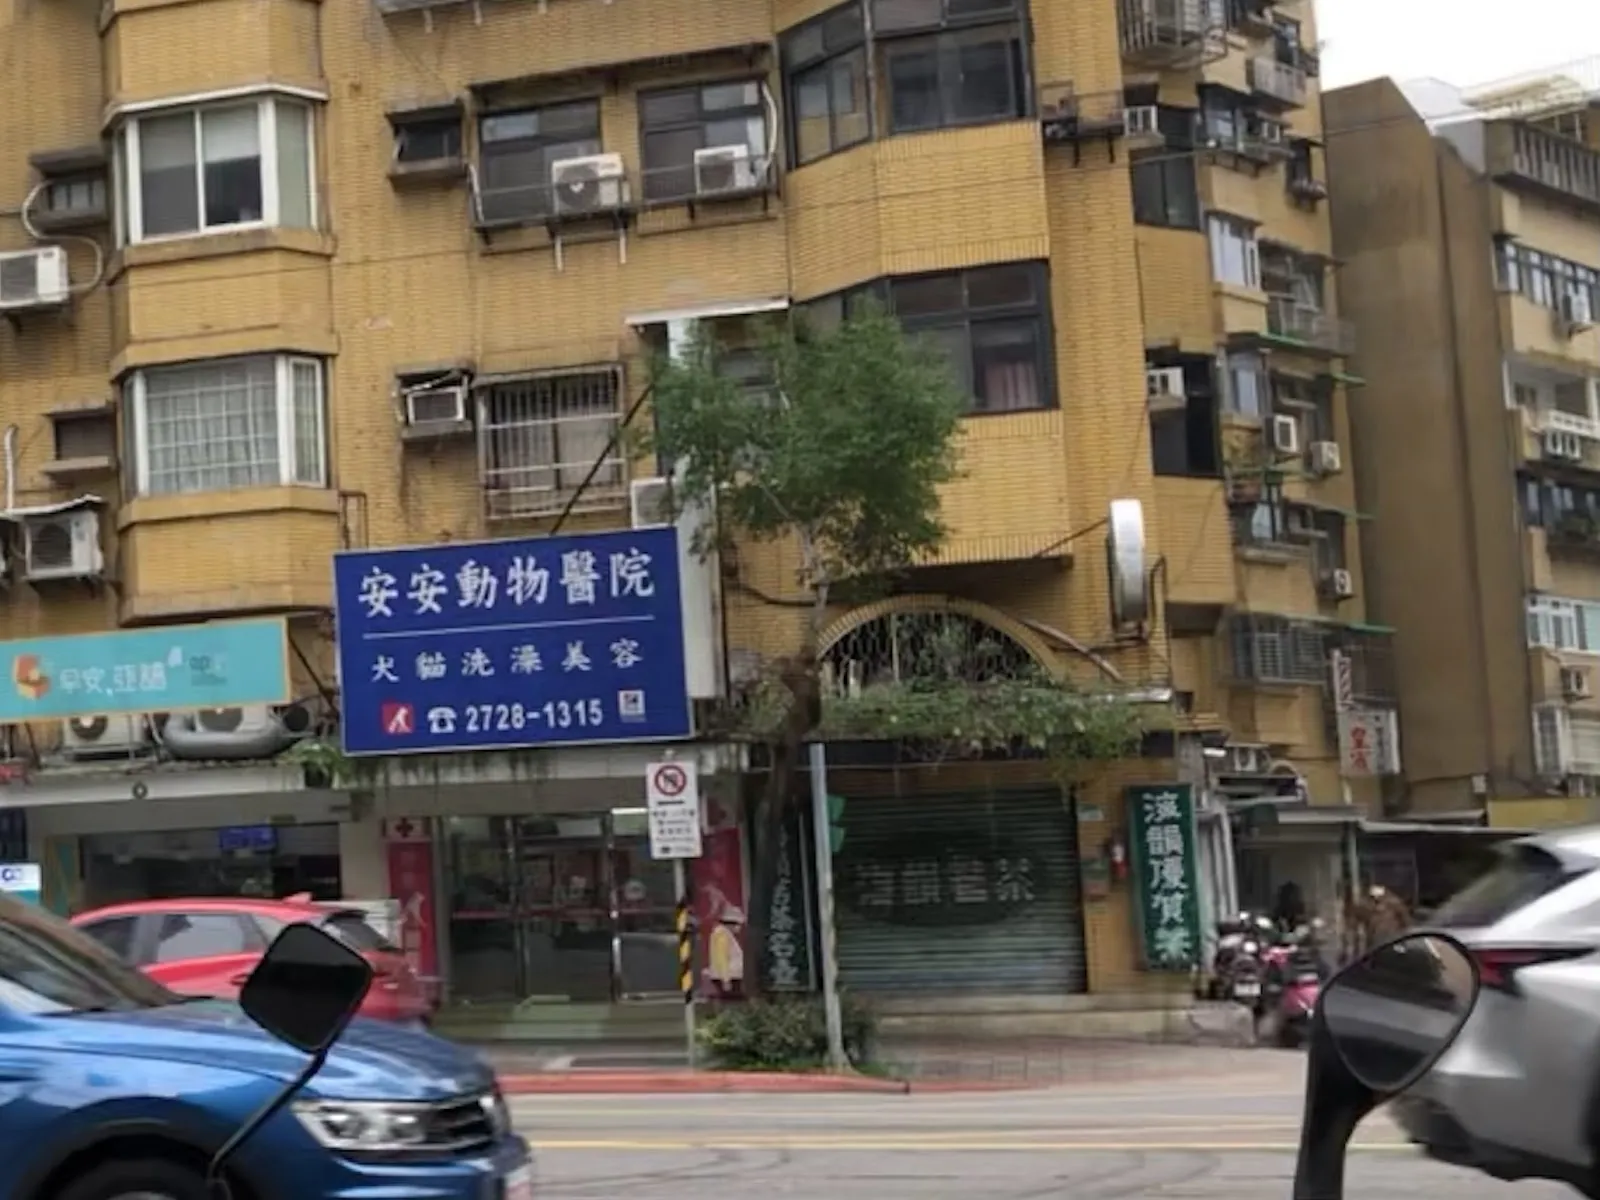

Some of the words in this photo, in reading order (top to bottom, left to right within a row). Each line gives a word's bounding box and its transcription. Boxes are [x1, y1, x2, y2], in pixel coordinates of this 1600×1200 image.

[358, 547, 656, 618] 安安動物醫院
[371, 637, 643, 683] 犬貓洗澡美容
[465, 699, 604, 733] 2728-1315
